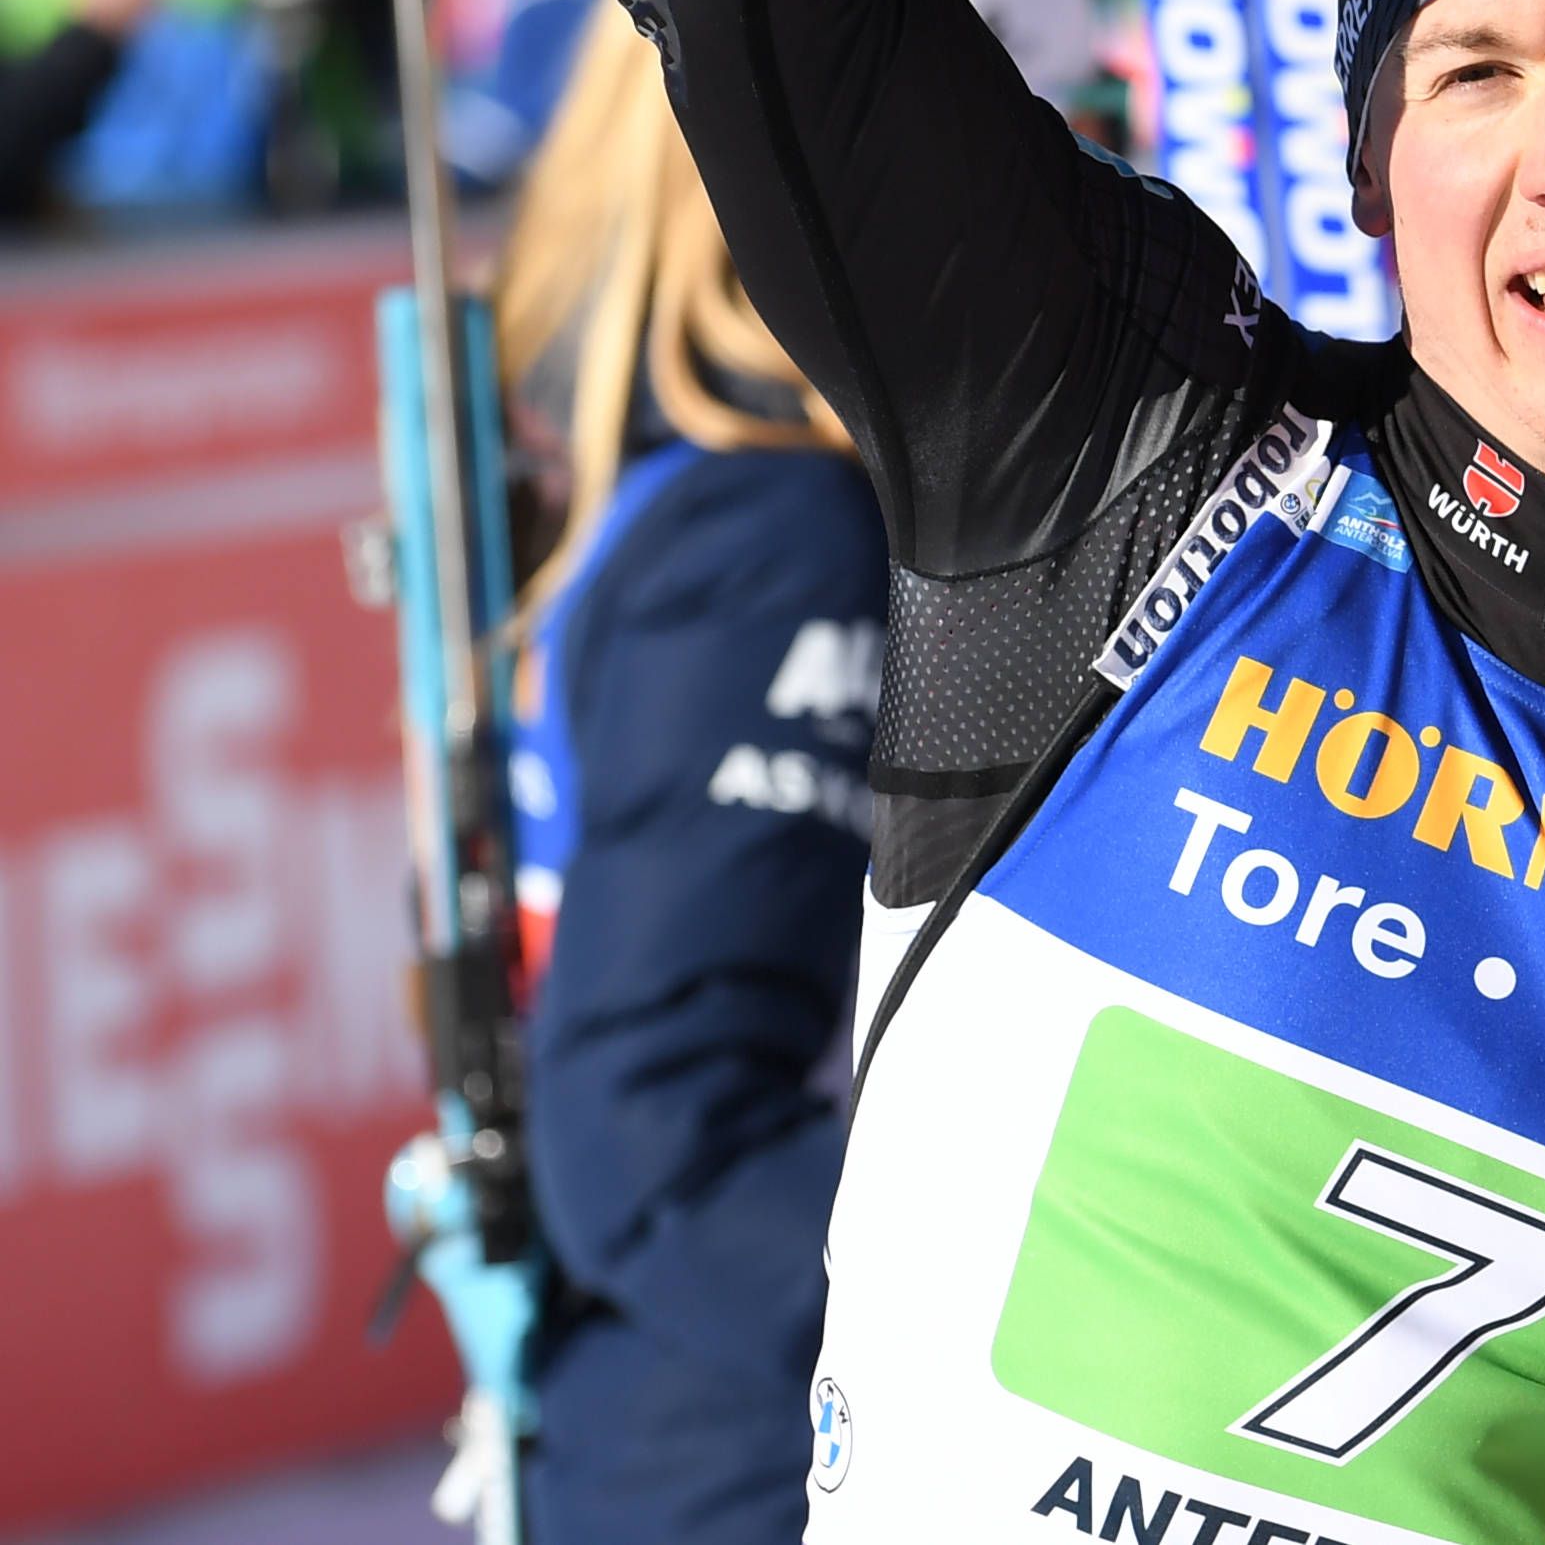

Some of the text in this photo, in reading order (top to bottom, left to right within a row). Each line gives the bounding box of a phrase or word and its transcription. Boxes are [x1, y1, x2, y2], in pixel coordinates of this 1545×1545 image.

[1114, 410, 1307, 669] robotron
[1337, 515, 1407, 551] ANTHOLZ
[1427, 484, 1530, 575] WÜRTH
[1167, 787, 1428, 982] Tore
[1031, 1455, 1348, 1545] ANT
